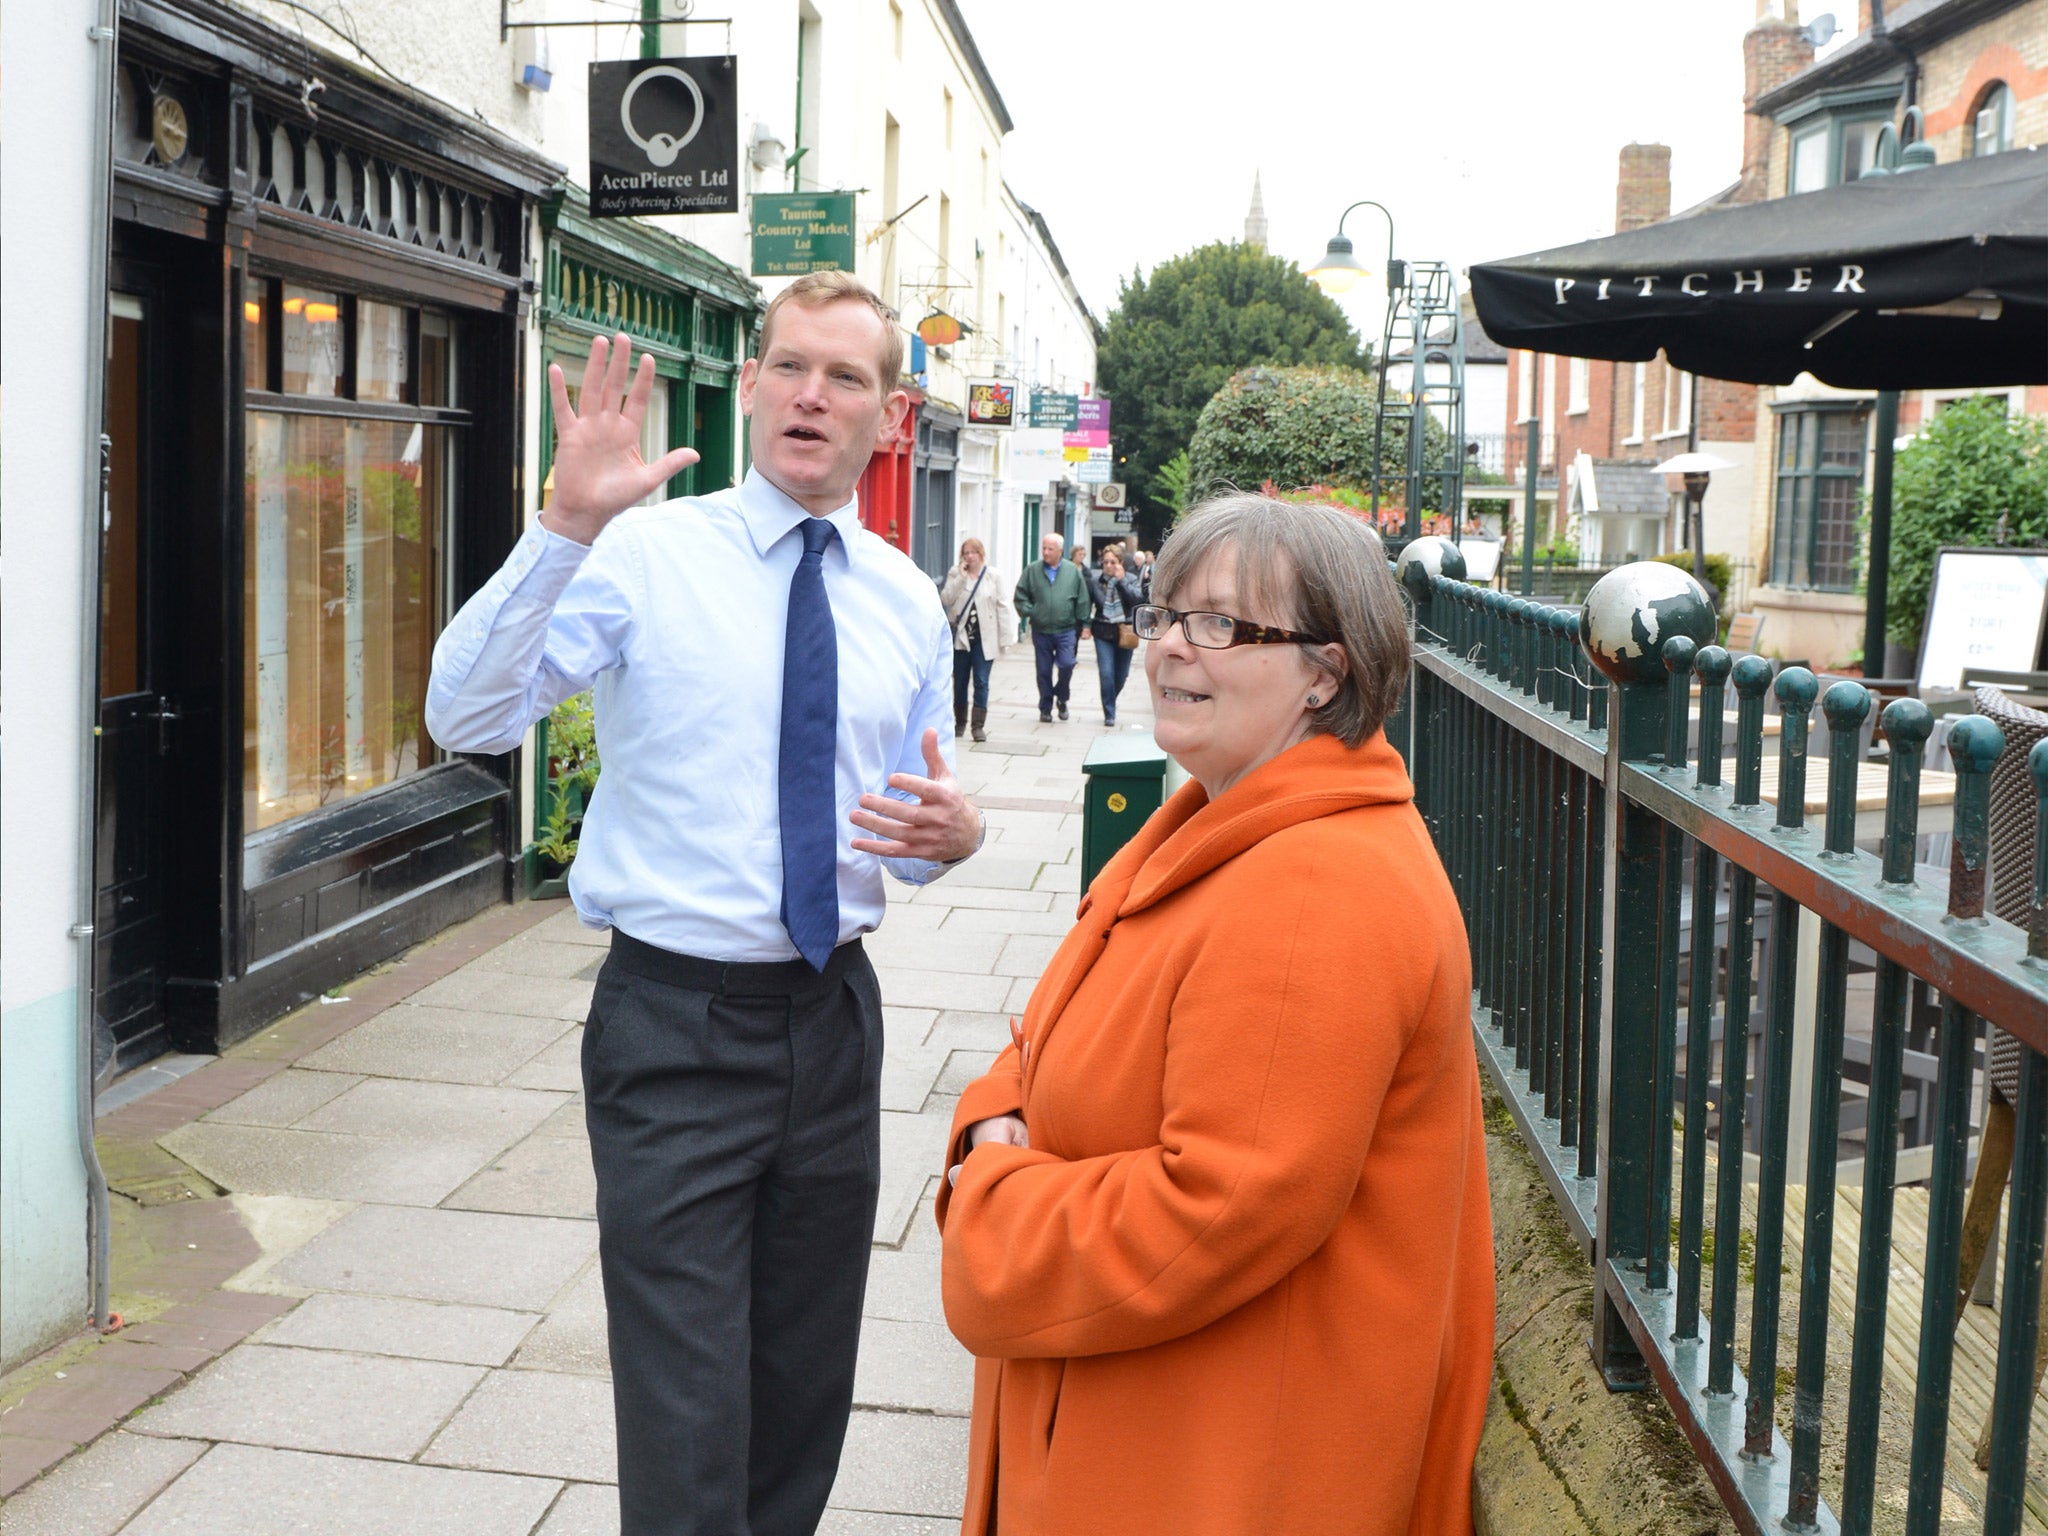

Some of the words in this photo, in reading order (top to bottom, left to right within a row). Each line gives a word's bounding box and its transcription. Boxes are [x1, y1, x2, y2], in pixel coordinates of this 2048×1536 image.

[599, 171, 693, 190] AccuPierce
[700, 169, 728, 187] Ltd
[601, 195, 627, 212] Body
[629, 195, 671, 211] Piercing
[672, 192, 728, 210] Specialists
[779, 207, 826, 220] Taunton
[757, 223, 804, 238] Country
[808, 222, 848, 235] Market
[795, 239, 811, 250] Ltd
[1554, 264, 1866, 305] PITCHER
